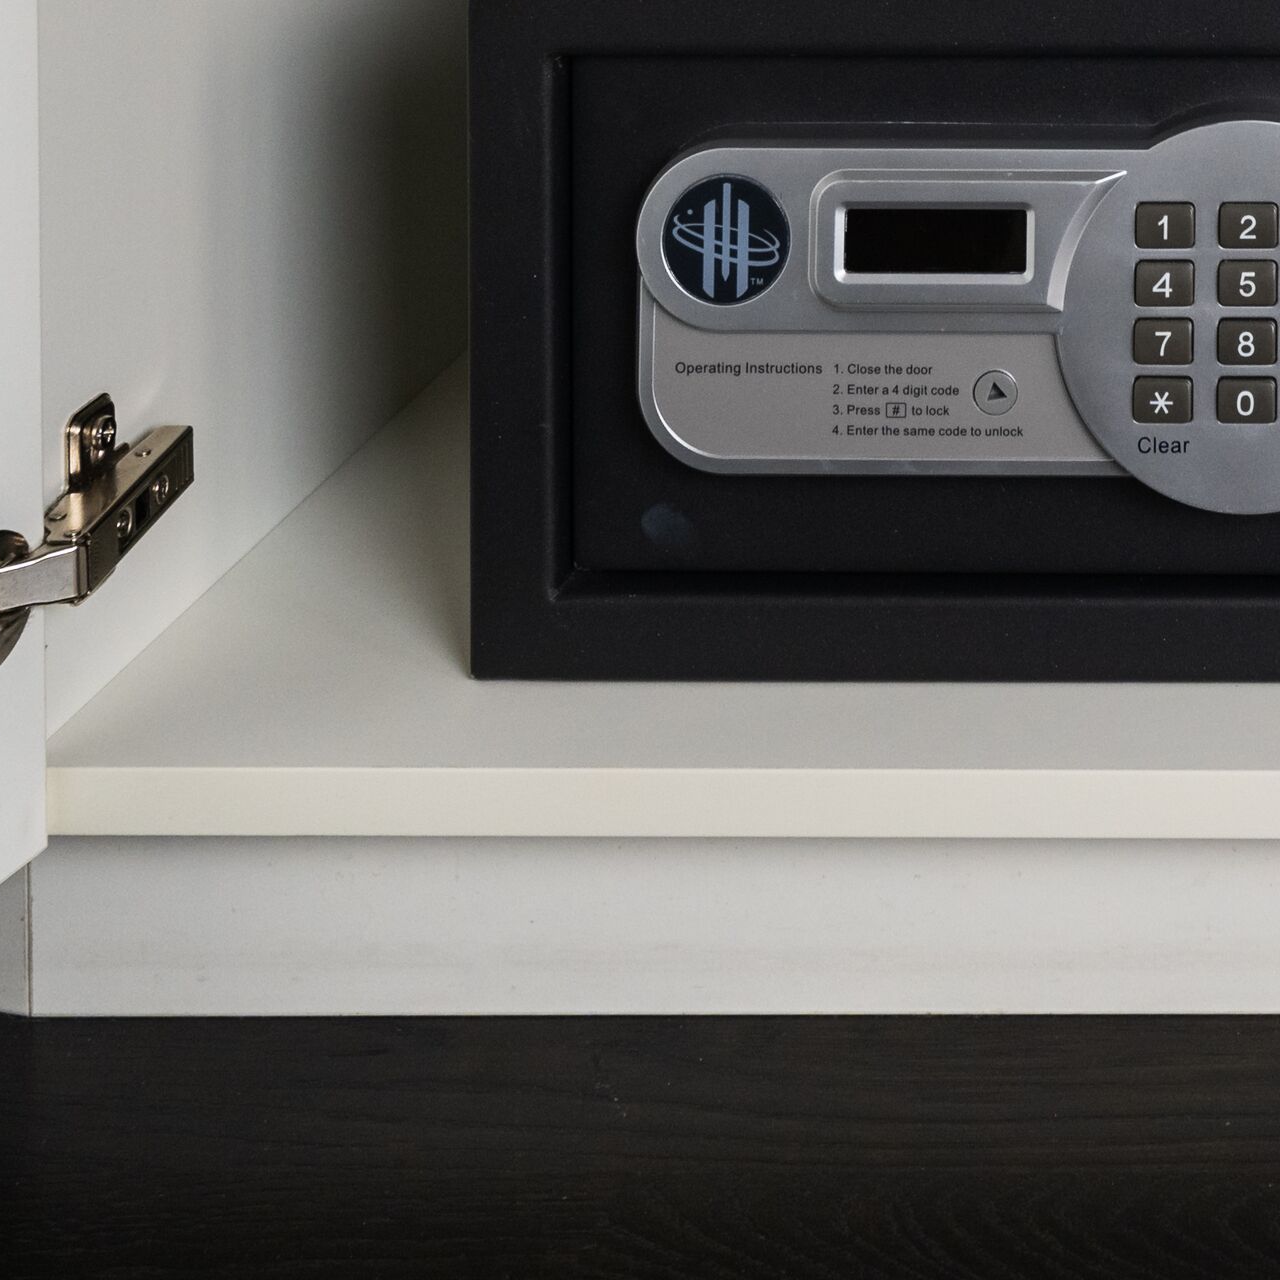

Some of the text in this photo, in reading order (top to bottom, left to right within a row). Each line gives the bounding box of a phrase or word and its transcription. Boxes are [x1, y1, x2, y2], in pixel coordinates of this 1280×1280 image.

[1158, 215, 1168, 240] 1
[1240, 215, 1256, 239] 2
[1153, 272, 1172, 298] 4
[1240, 272, 1255, 297] 5
[1155, 332, 1171, 356] 7
[1238, 332, 1254, 357] 8
[674, 362, 823, 377] Operating Instructions
[833, 364, 933, 376] 1. Close the door
[832, 384, 960, 399] 2. Enter a 4 digit code
[832, 404, 950, 417] 3. Press # to lock
[1237, 391, 1254, 416] 0
[831, 425, 1024, 438] 4. Enter the same code to unlock
[1137, 437, 1190, 455] Clear
